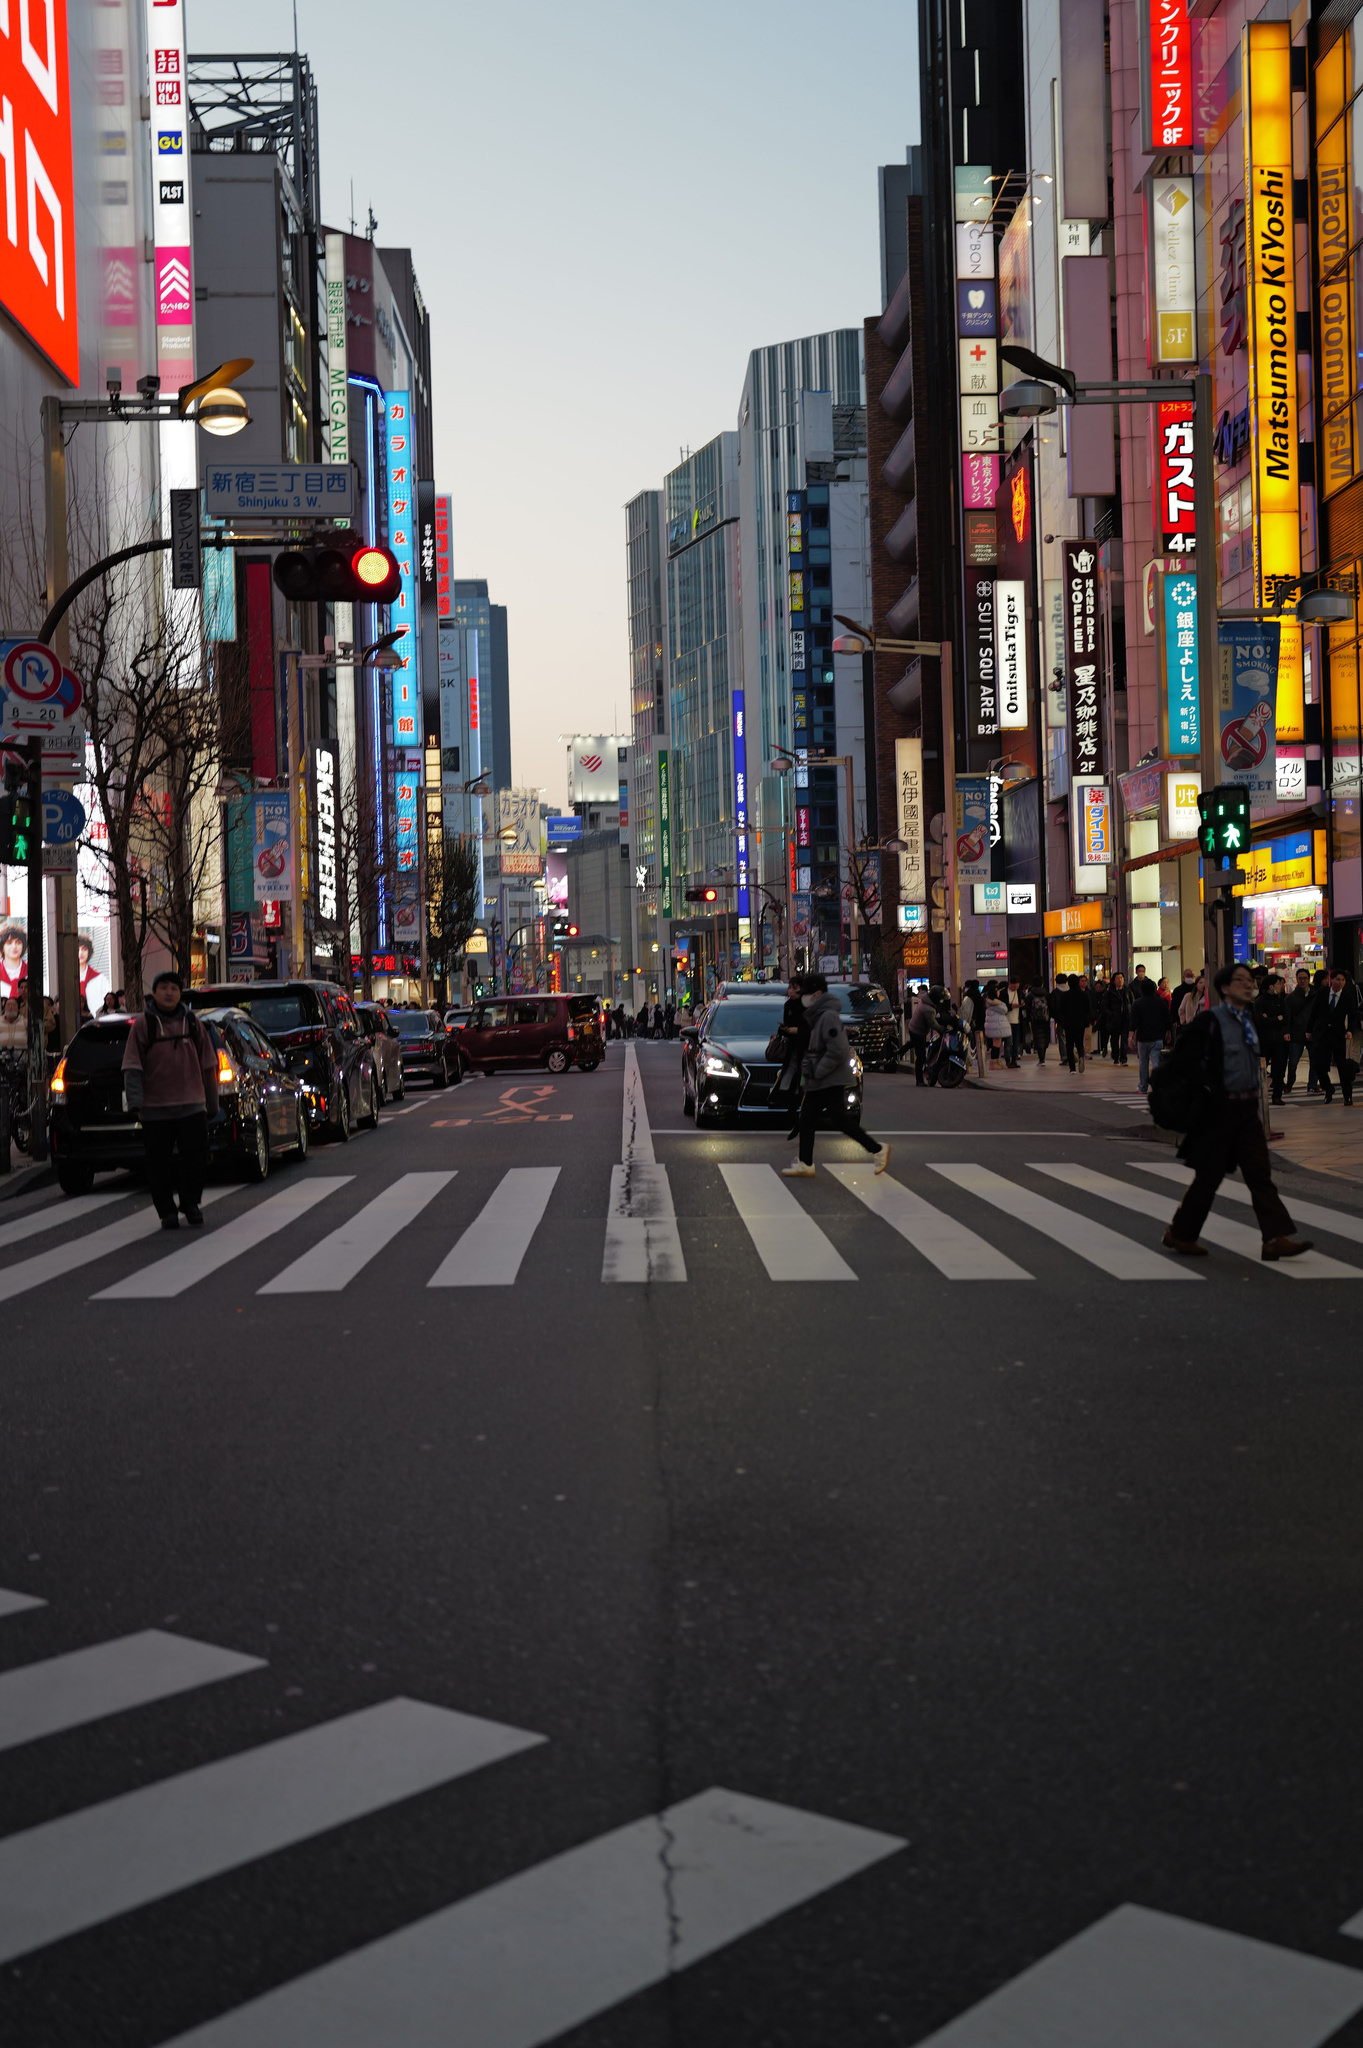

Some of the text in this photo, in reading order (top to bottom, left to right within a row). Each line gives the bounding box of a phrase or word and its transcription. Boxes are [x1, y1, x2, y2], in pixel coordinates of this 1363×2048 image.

[157, 82, 178, 93] UNI
[158, 93, 180, 104] QLO
[159, 135, 182, 150] GU
[1163, 128, 1184, 145] 8F
[161, 186, 182, 199] PLST
[1166, 221, 1180, 305] Fellez Clinic
[160, 302, 190, 310] DAISO
[1259, 168, 1290, 481] Matsumoto KiYoshi
[1165, 327, 1188, 345] 5F
[330, 367, 347, 462] MEGANE
[982, 455, 994, 506] 東京ダンス
[1164, 420, 1195, 525] ガスト
[211, 472, 347, 494] 新宿三丁目西
[238, 495, 289, 509] Shinjuku
[293, 496, 301, 507] 3
[1169, 534, 1196, 553] 4F
[1072, 577, 1084, 653] COFFEE
[1085, 578, 1096, 653] HAND DRIP
[1176, 610, 1196, 702] 銀座よしえ
[1235, 644, 1273, 659] NO!
[1236, 660, 1278, 675] SMOKING
[12, 707, 20, 718] 8
[39, 708, 56, 720] 20
[1073, 663, 1098, 759] 星乃珈琲店
[977, 724, 999, 735] B2F
[1080, 760, 1096, 773] 2F
[965, 792, 987, 801] NO!
[1087, 787, 1106, 803] 薬
[902, 770, 920, 873] 紀伊國屋書店
[1089, 806, 1104, 852] ダイコク
[57, 823, 73, 839] 40
[315, 747, 337, 921] SKECHERS
